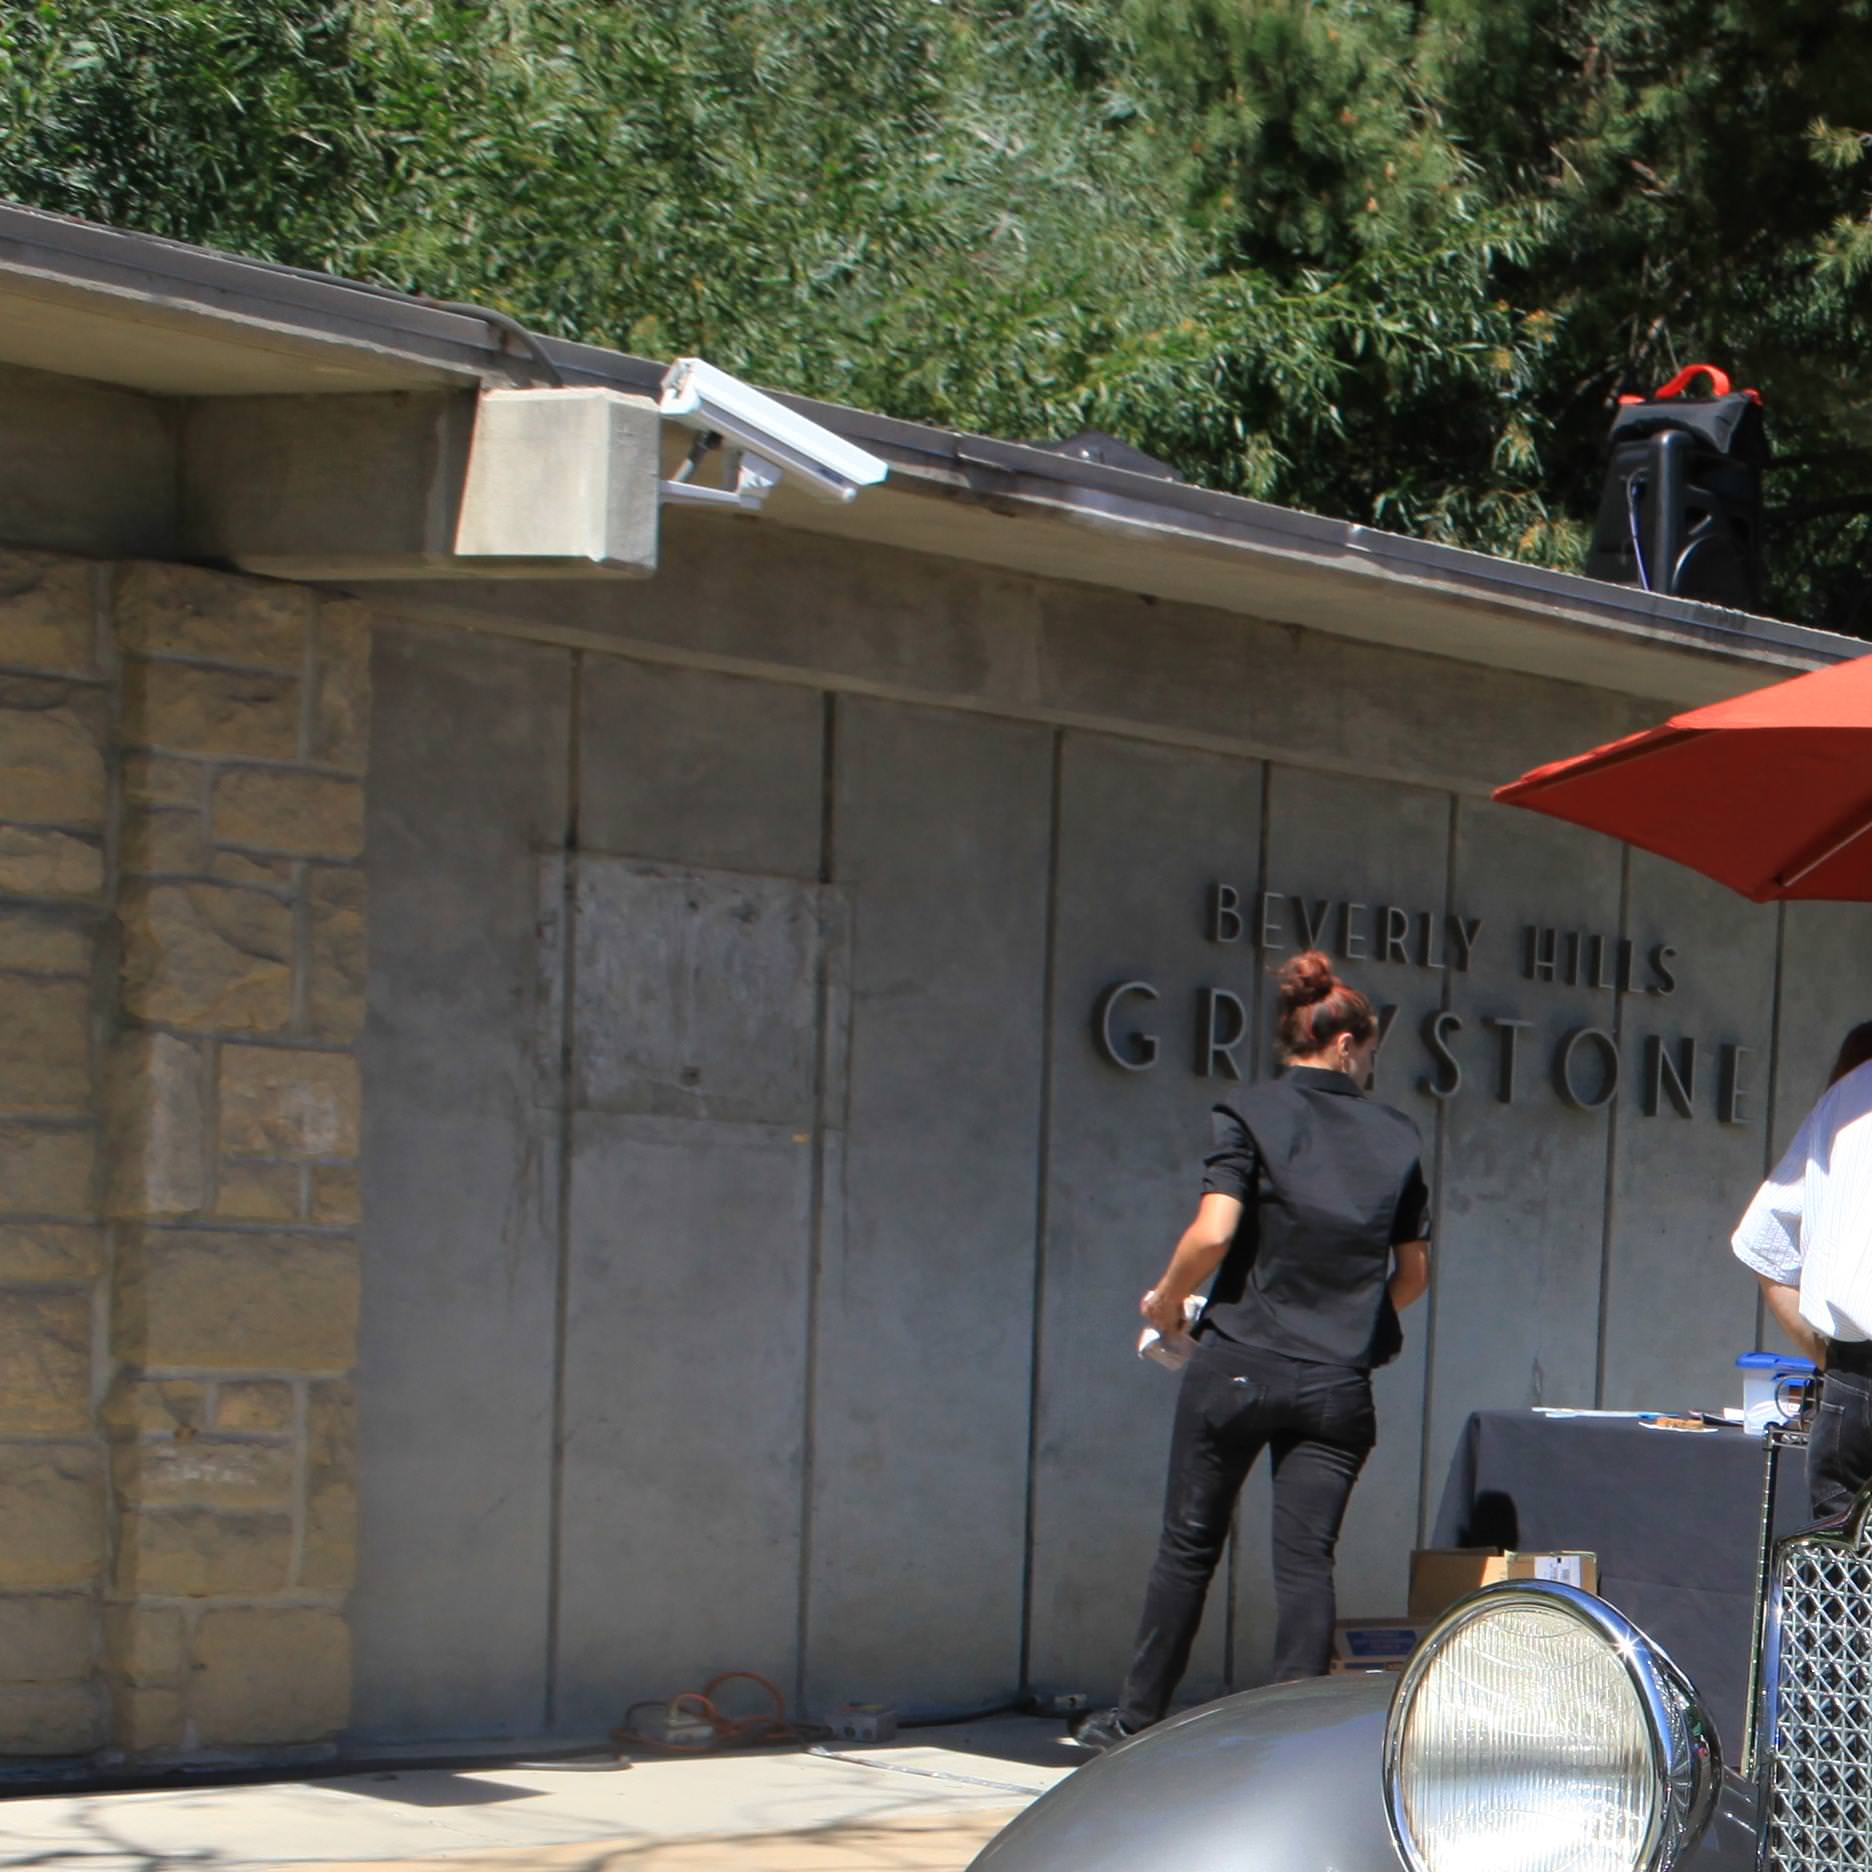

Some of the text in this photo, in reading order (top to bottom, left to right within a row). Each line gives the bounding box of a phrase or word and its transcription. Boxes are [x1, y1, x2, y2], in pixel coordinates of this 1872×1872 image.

[1208, 883, 1677, 997] BEVERLY HILLS
[1096, 980, 1755, 1125] GRYSTONE
